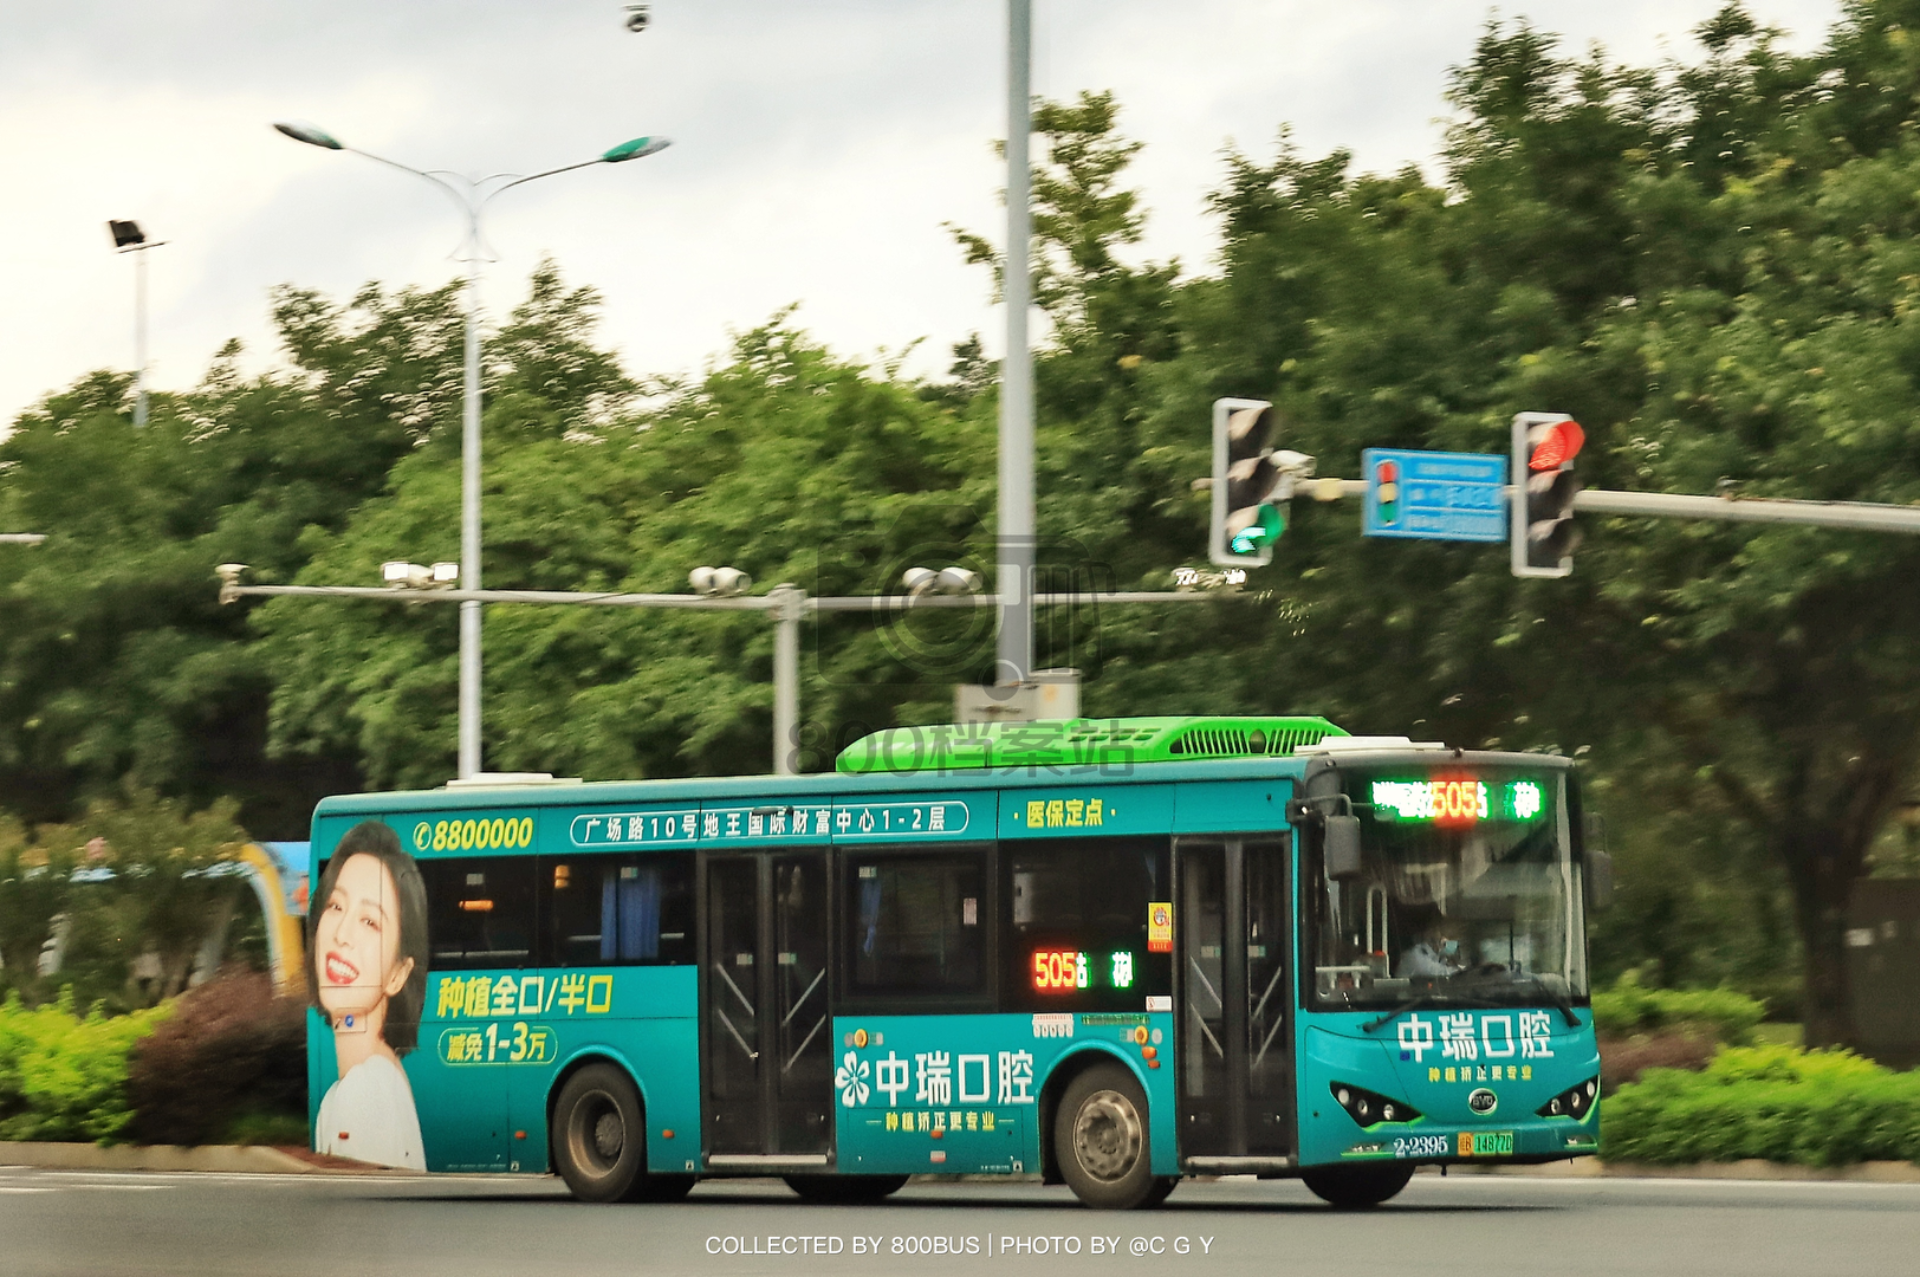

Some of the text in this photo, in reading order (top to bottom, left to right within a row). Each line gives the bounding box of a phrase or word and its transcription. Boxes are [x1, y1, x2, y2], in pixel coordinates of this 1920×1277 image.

[1026, 798, 1103, 828] 医保定点
[1432, 781, 1477, 818] 505
[432, 817, 534, 851] 8800000
[584, 806, 946, 842] 广场路10号地王国际财富中心1-2层
[1035, 952, 1076, 987] 505
[437, 974, 614, 1018] 种植全口/半口
[447, 1021, 547, 1062] 减免1-3万
[1397, 1010, 1555, 1063] 中瑞口腔
[875, 1049, 1035, 1107] 中瑞口腔
[1472, 1095, 1494, 1107] BYD
[885, 1111, 995, 1132] 种植矫正更专业
[1393, 1135, 1449, 1158] 2-2395
